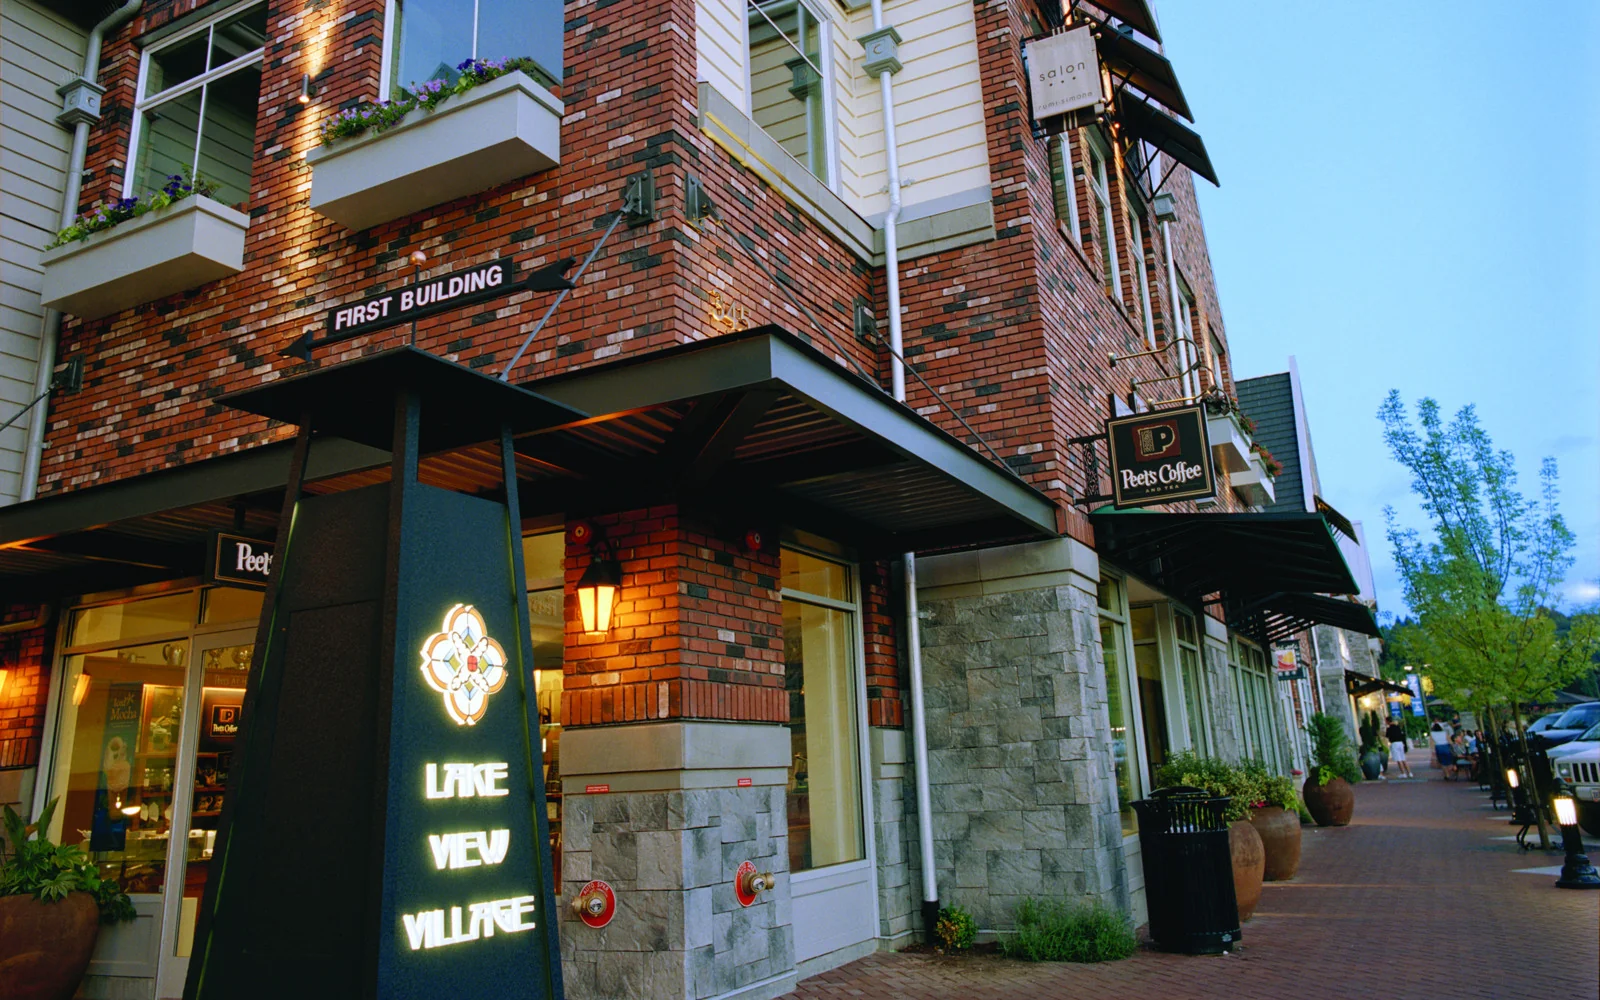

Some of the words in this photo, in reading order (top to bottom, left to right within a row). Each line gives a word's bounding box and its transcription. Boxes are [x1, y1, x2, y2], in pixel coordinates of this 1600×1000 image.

[1040, 62, 1085, 81] salon
[334, 296, 393, 330] FIRST
[400, 265, 503, 311] BUILDING
[1158, 461, 1203, 483] Coffee
[425, 762, 510, 799] LAKE
[428, 829, 510, 870] VIEW
[402, 895, 536, 950] VILLAGE
